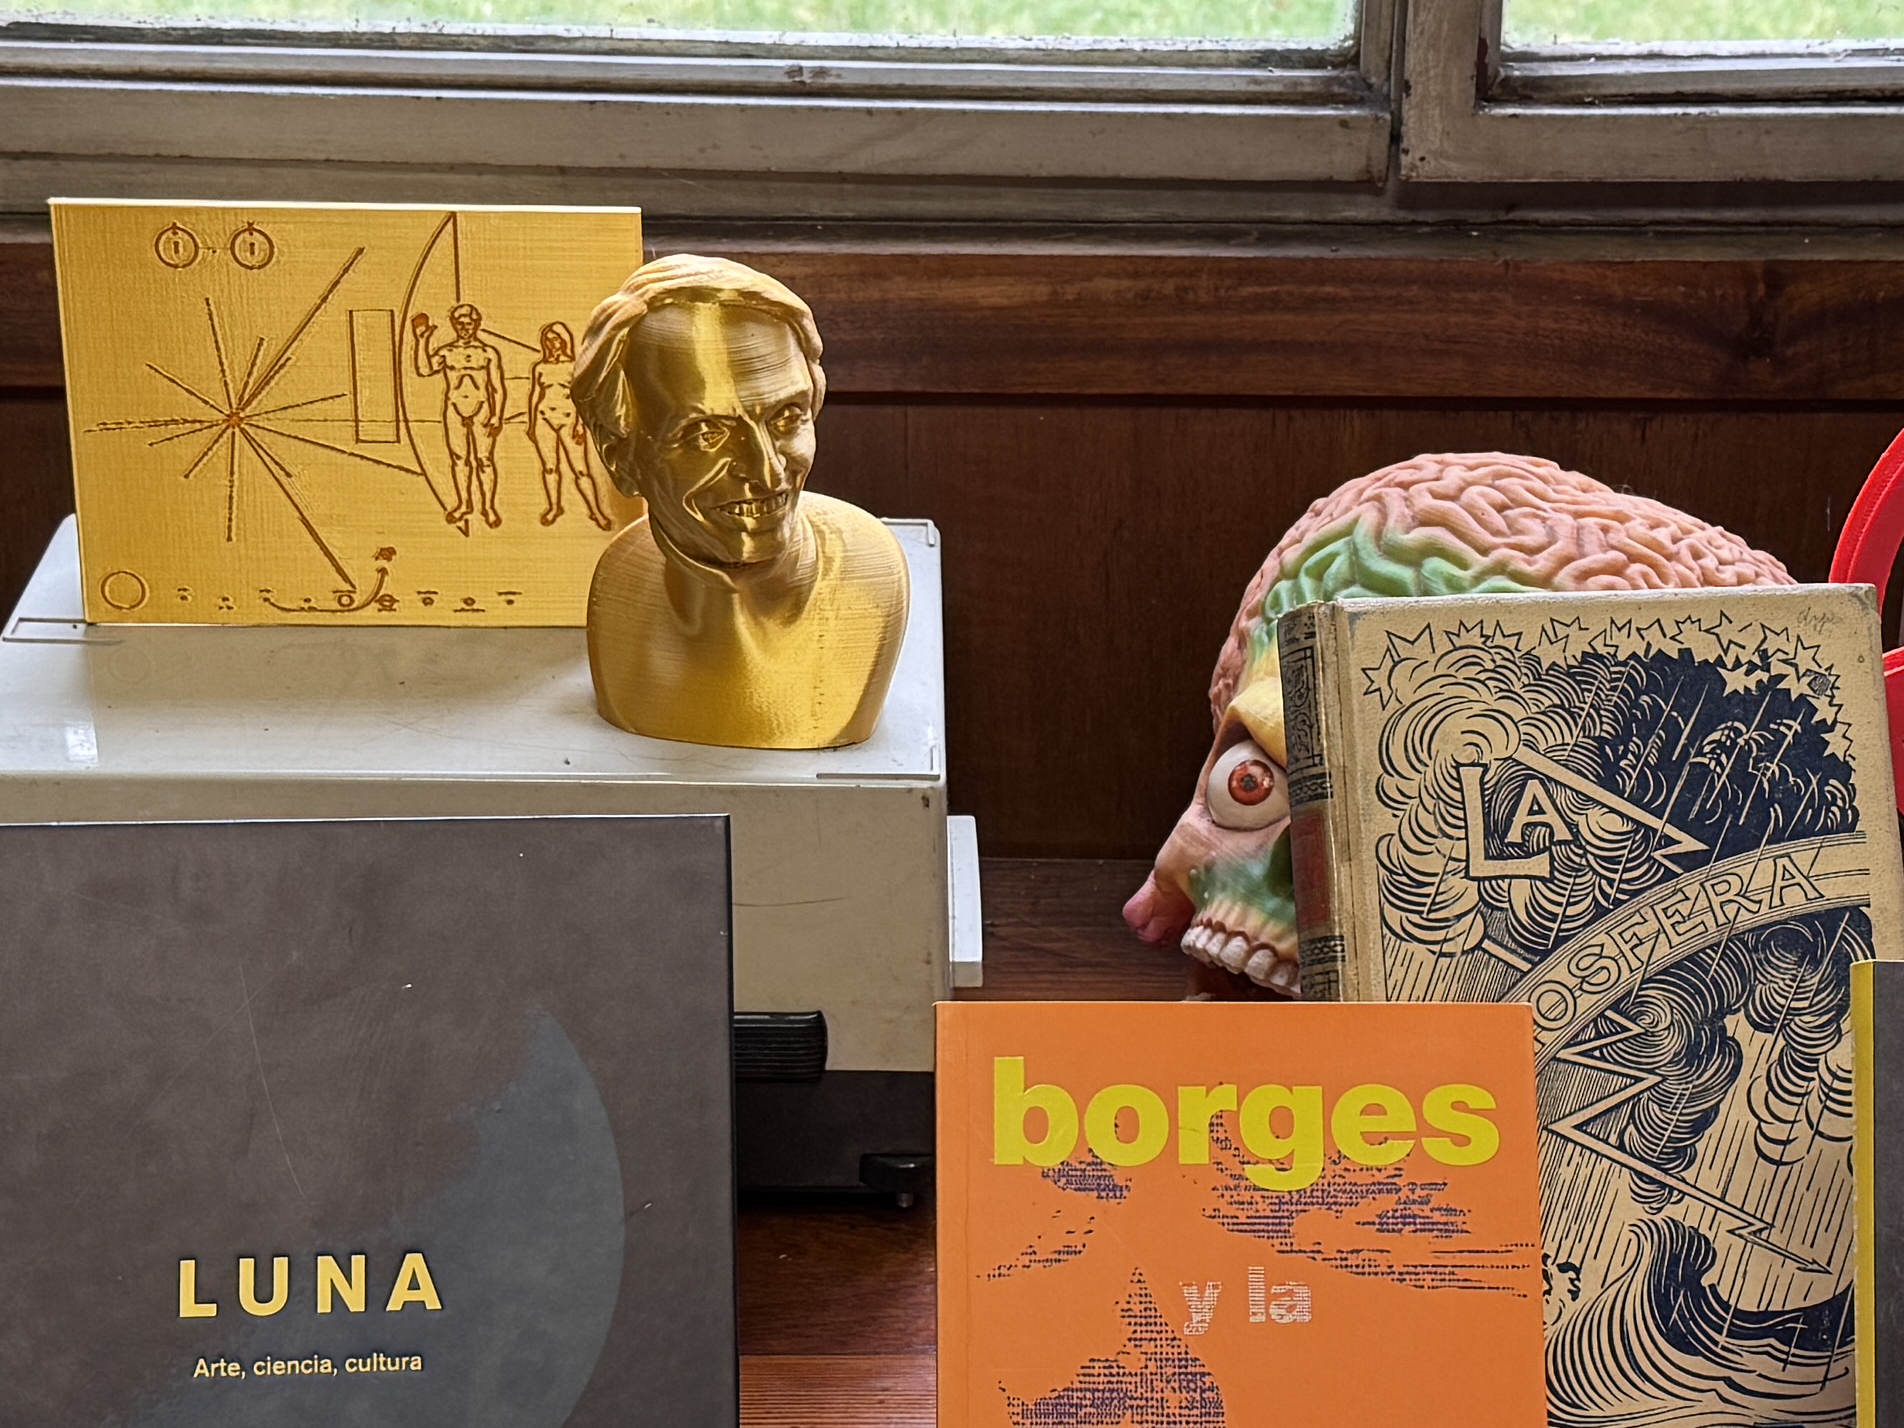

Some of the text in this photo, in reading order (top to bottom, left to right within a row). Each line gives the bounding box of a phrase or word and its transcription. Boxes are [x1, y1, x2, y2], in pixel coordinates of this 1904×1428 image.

[1456, 763, 1572, 884] LA
[1535, 855, 1826, 1047] OSFERA
[992, 1055, 1502, 1193] borges
[179, 1252, 443, 1318] LUNA
[1178, 1265, 1313, 1336] y la
[193, 1352, 423, 1380] Arte, ciencia, cultura
